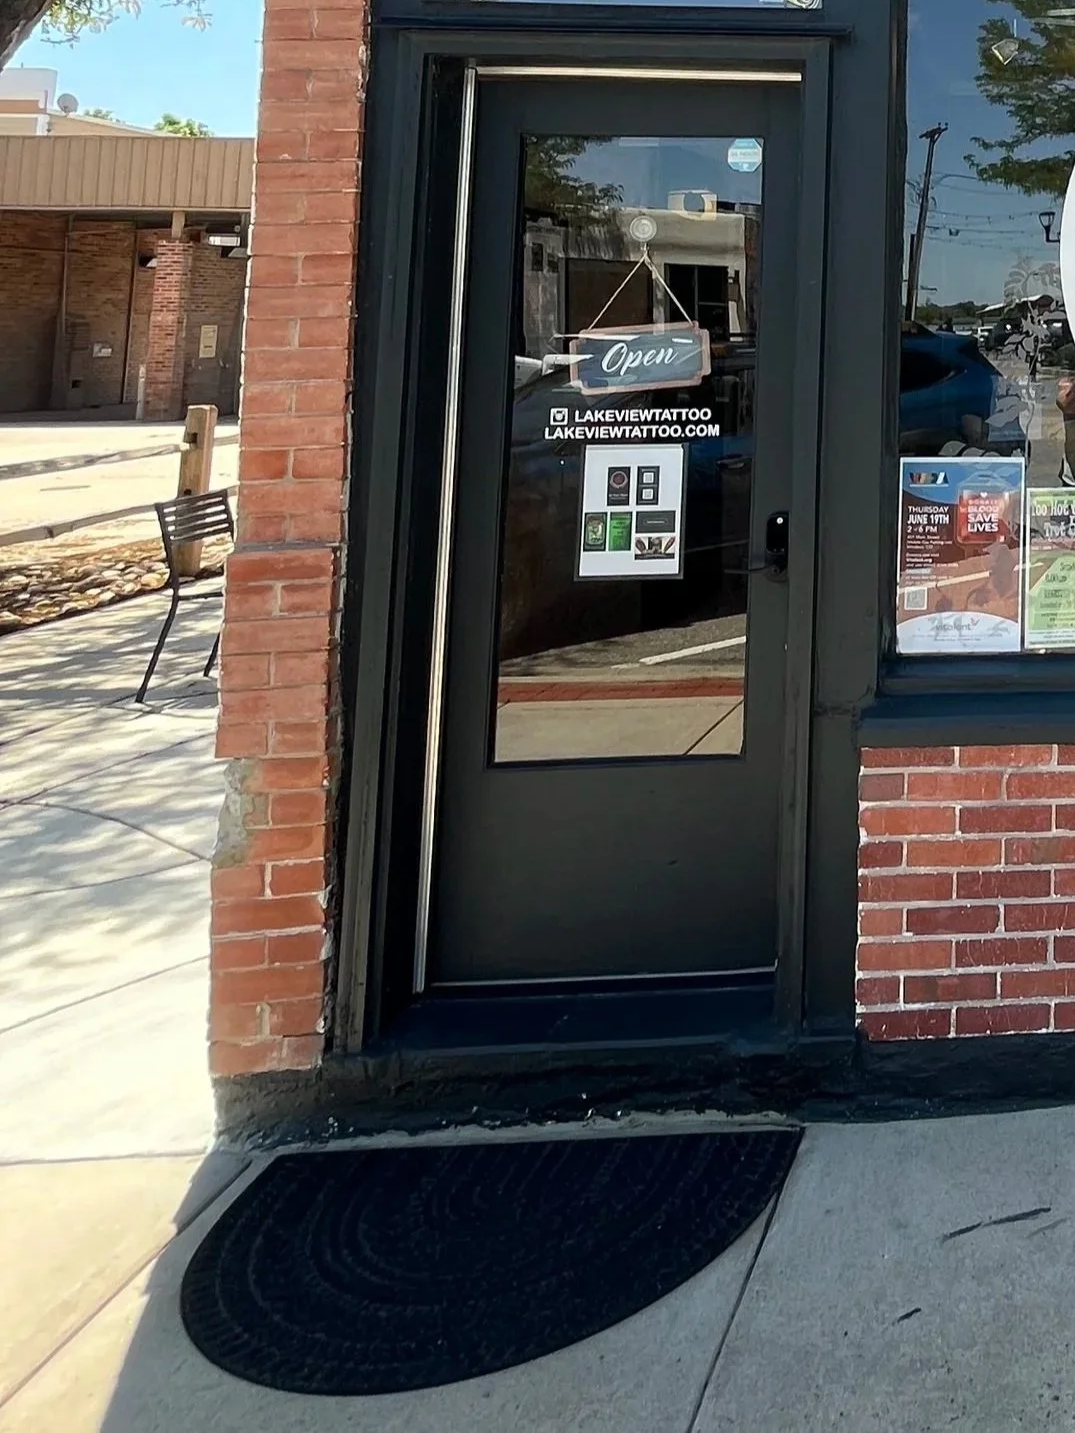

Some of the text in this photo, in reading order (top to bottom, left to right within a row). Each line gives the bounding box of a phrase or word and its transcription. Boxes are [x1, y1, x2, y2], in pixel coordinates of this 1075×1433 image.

[601, 342, 680, 377] Open
[574, 407, 712, 424] LAKEVIEWTATTOO
[544, 423, 720, 441] LAKEVIEWTATTOO.COM
[907, 505, 949, 513] THURSDAY
[967, 505, 999, 513] BLOOD
[1050, 499, 1069, 515] Hot
[907, 513, 949, 525] JUNE 19TH
[967, 513, 999, 523] SAVE
[925, 525, 938, 533] PM
[967, 522, 999, 533] LIVES
